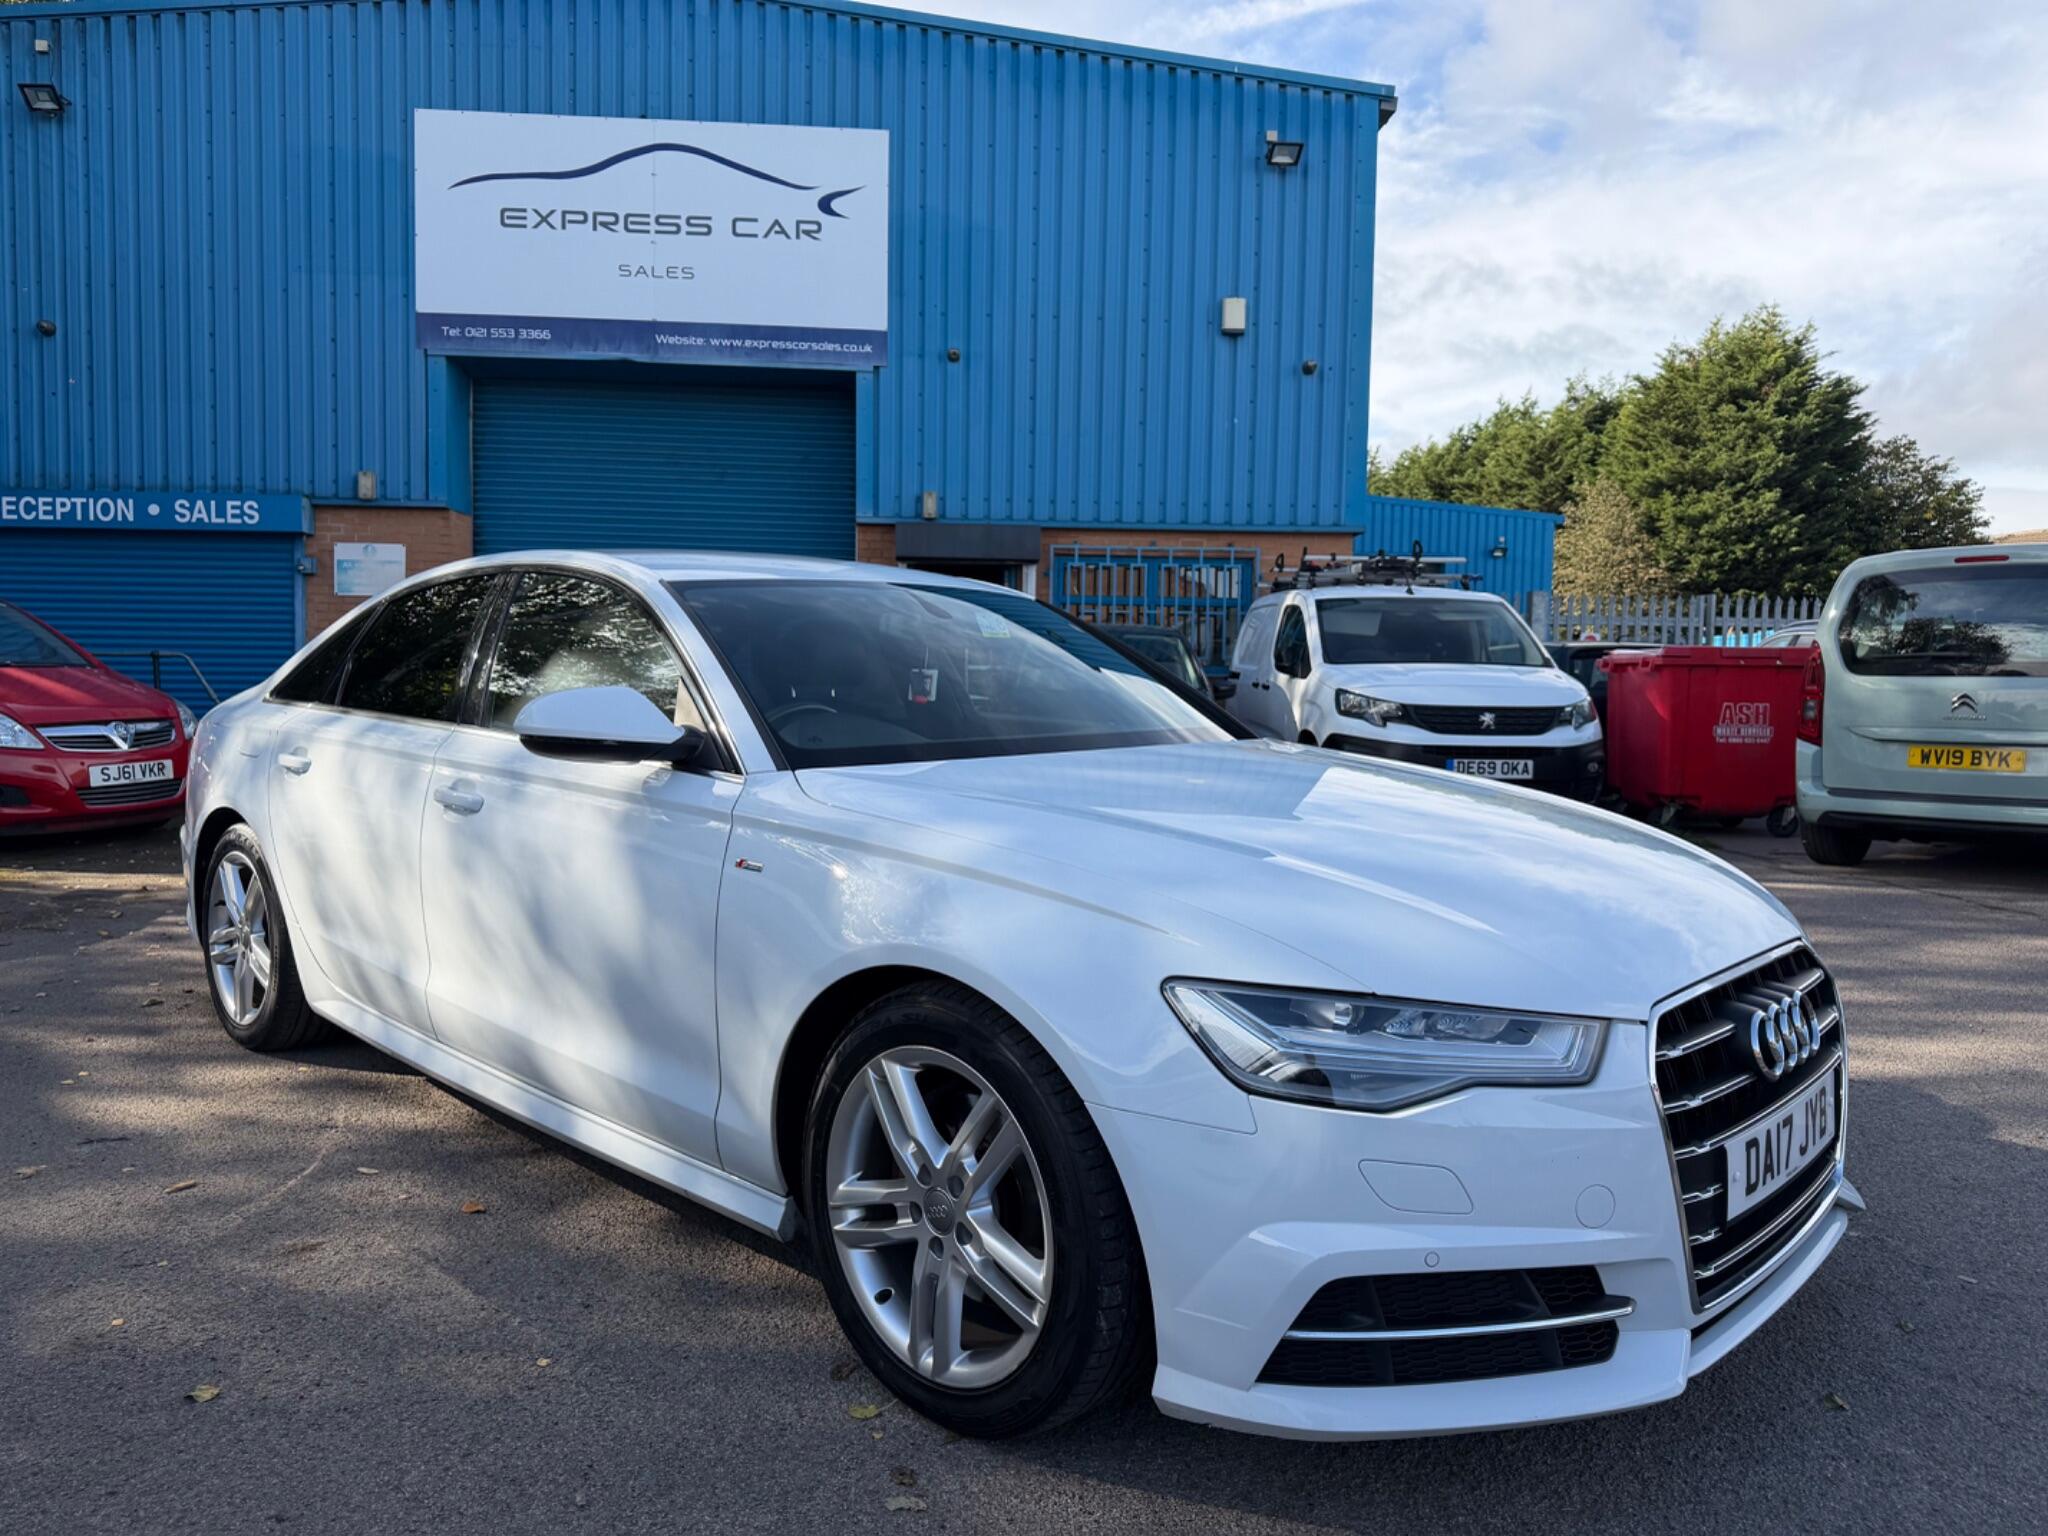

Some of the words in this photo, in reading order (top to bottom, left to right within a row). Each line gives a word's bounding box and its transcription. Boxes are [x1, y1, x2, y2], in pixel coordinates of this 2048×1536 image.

[500, 207, 712, 237] EXPRESS
[731, 217, 823, 241] CAR
[618, 264, 695, 280] SALES
[464, 327, 487, 338] 0121
[490, 328, 516, 338] 553
[518, 329, 552, 340] 3366
[655, 334, 706, 346] Website:
[709, 338, 873, 353] www.expresscarsales.co.uk
[174, 499, 260, 525] SALES
[1719, 702, 1770, 726] ASH
[1456, 760, 1497, 775] DE69
[1501, 761, 1530, 776] OKA
[1920, 748, 1965, 766] WV19
[1970, 750, 2012, 768] BYK
[101, 765, 136, 782] SJ61
[139, 762, 166, 778] VKR
[1745, 1114, 1793, 1196] DA17
[1799, 1086, 1826, 1156] JYB
